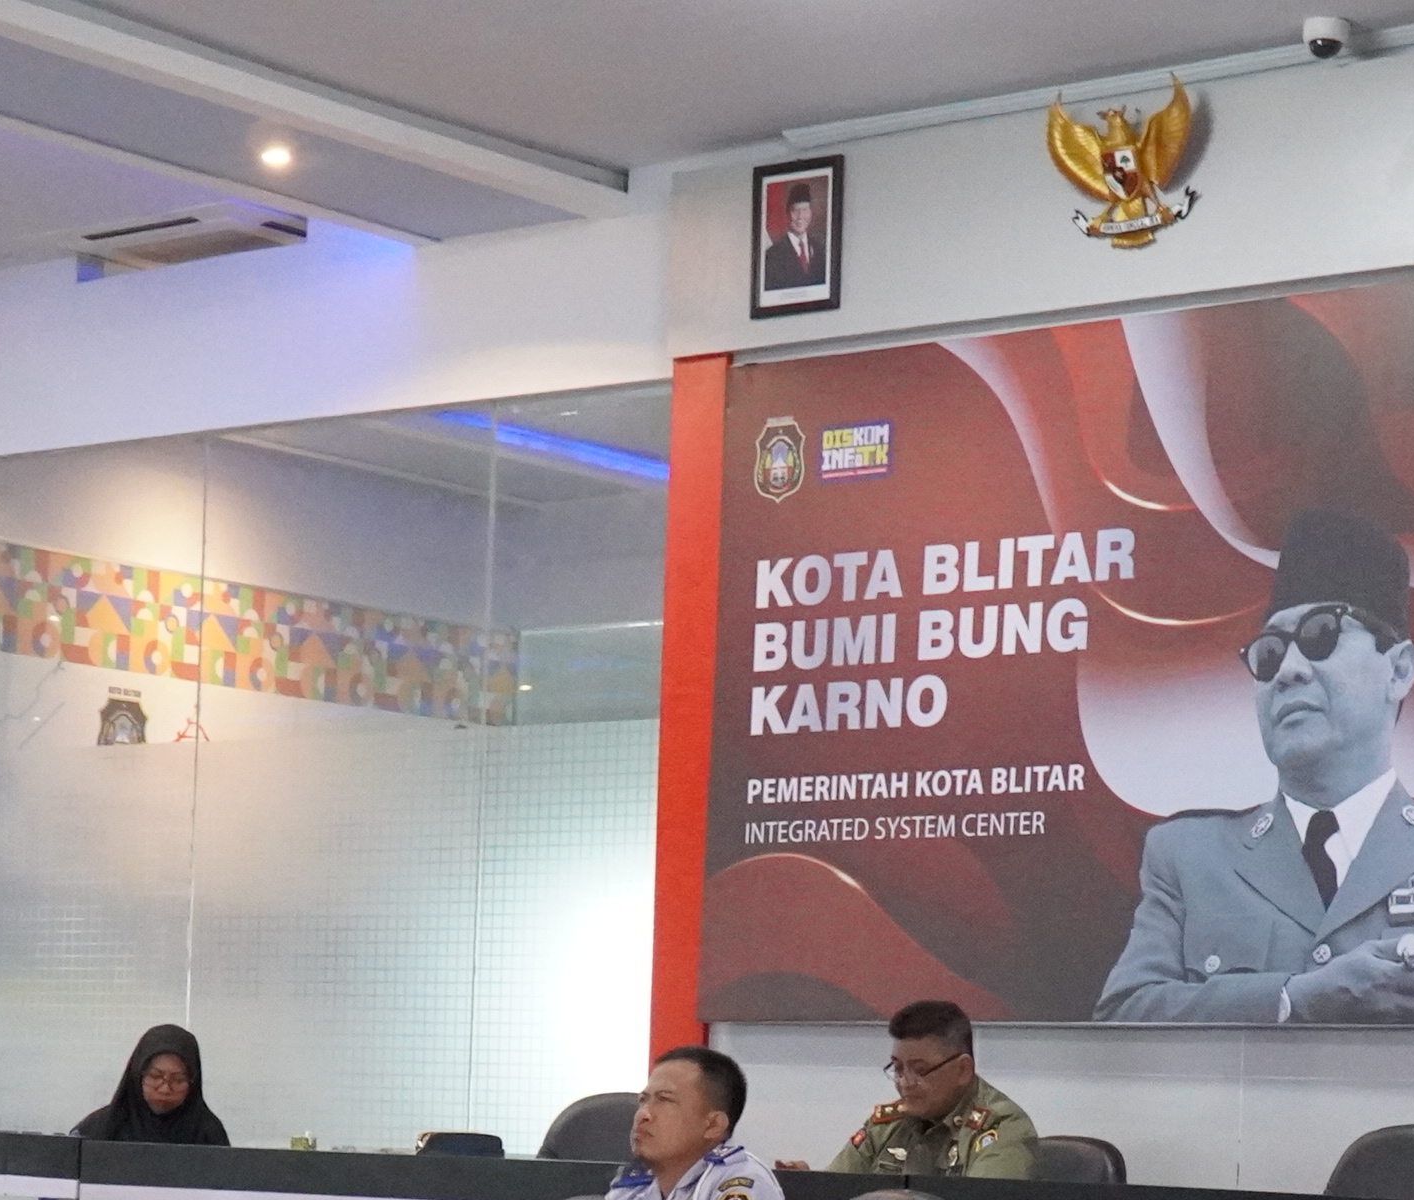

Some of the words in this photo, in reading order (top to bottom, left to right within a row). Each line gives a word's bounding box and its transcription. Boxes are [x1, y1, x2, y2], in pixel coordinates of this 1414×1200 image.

[822, 423, 890, 450] DISKOM
[755, 549, 903, 609] KOTA
[922, 527, 1136, 596] BLITAR
[753, 612, 897, 673] BUMI
[917, 597, 1088, 661] BUNG
[749, 673, 948, 736] KARNO
[746, 772, 909, 805] PEMERINTAH
[914, 769, 984, 798] KOTA
[990, 763, 1085, 795] BLITAR
[744, 817, 870, 845] INTEGRATED
[874, 814, 956, 841] SYSTEM
[961, 811, 1046, 838] CENTER
